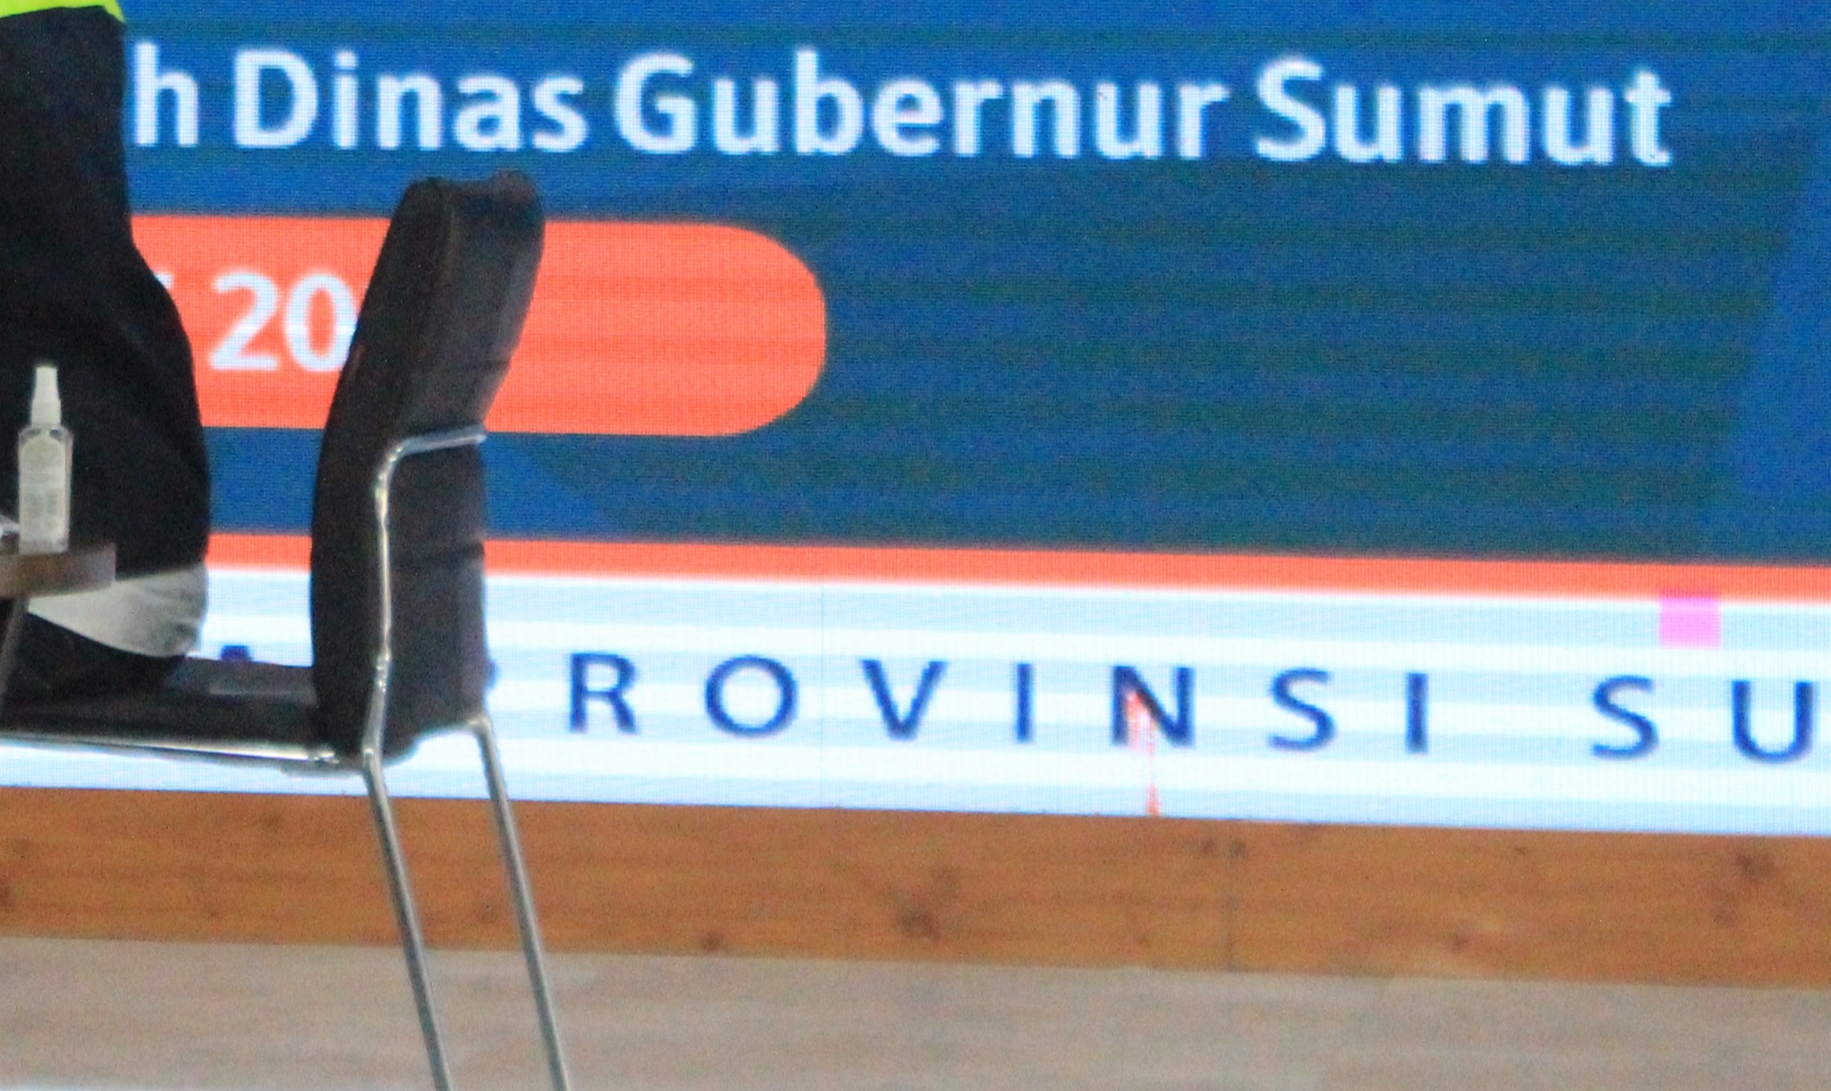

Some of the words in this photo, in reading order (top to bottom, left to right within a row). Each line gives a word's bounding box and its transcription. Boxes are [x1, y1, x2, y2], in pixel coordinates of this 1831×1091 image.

[234, 49, 587, 153] Dinas
[616, 51, 1228, 159] Gubernur
[1257, 58, 1671, 165] Sumut
[486, 651, 1429, 754] ROVINSI
[1591, 674, 1815, 764] SU
